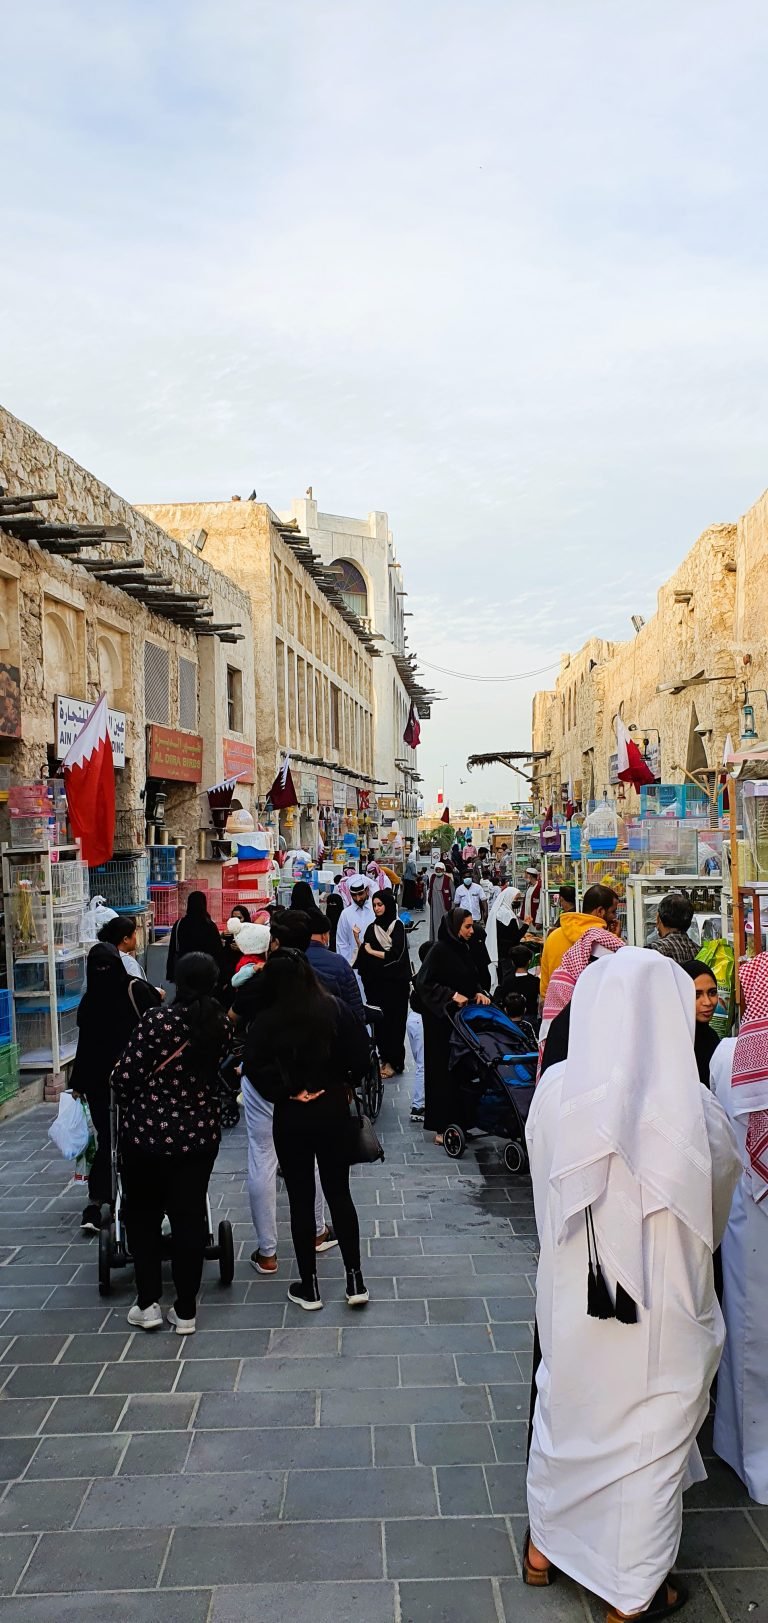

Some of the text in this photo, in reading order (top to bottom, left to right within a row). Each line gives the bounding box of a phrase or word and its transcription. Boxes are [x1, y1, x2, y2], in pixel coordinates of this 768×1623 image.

[60, 730, 72, 746] AIN
[111, 740, 124, 754] DING
[154, 751, 164, 764] AL
[182, 757, 201, 769] BIRDS
